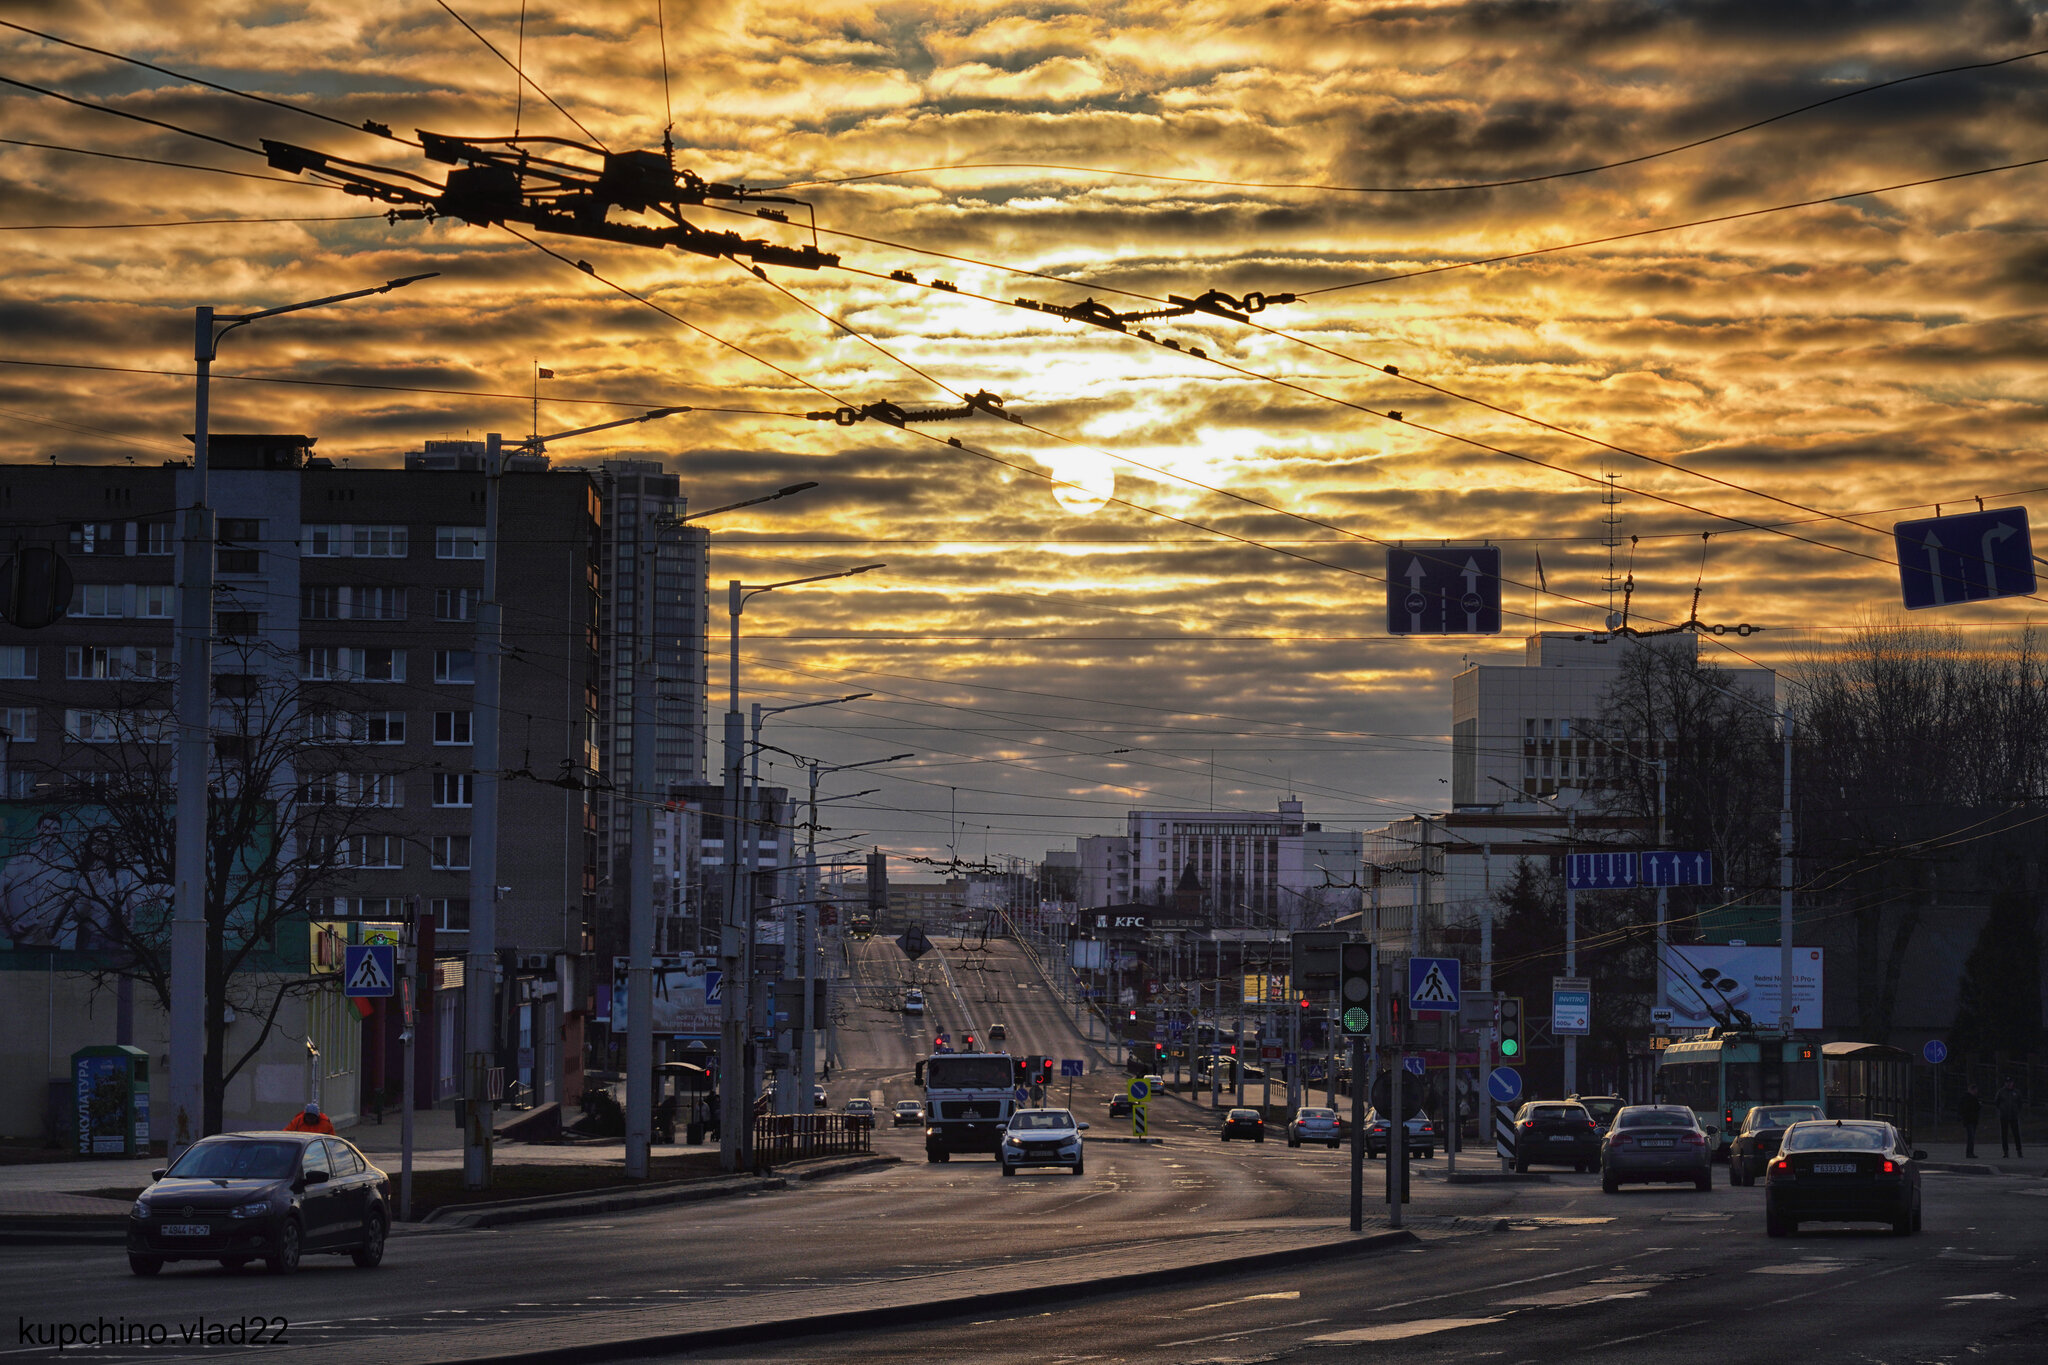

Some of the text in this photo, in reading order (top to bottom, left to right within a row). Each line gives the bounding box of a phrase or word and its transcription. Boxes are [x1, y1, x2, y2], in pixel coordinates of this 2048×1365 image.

[1115, 917, 1144, 927] KFC
[1803, 1050, 1811, 1058] 13
[78, 1059, 90, 1154] МАКУЛАТУРА
